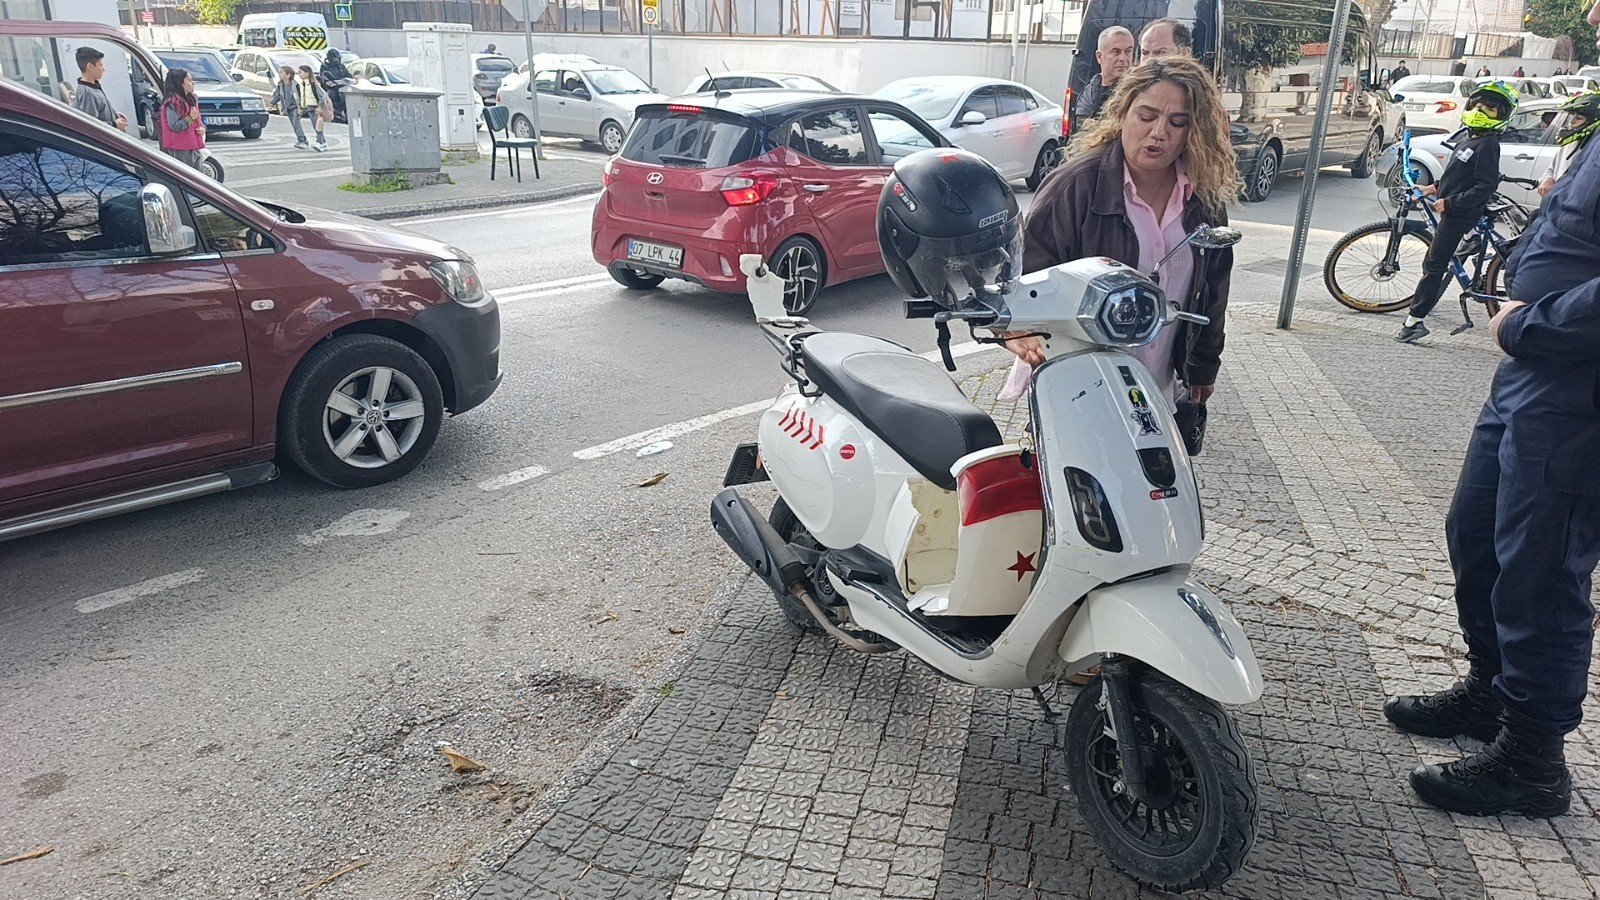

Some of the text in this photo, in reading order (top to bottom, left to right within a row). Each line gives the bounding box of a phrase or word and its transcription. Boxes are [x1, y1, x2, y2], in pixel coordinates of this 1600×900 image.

[633, 243, 680, 262] 07 LPK 44
